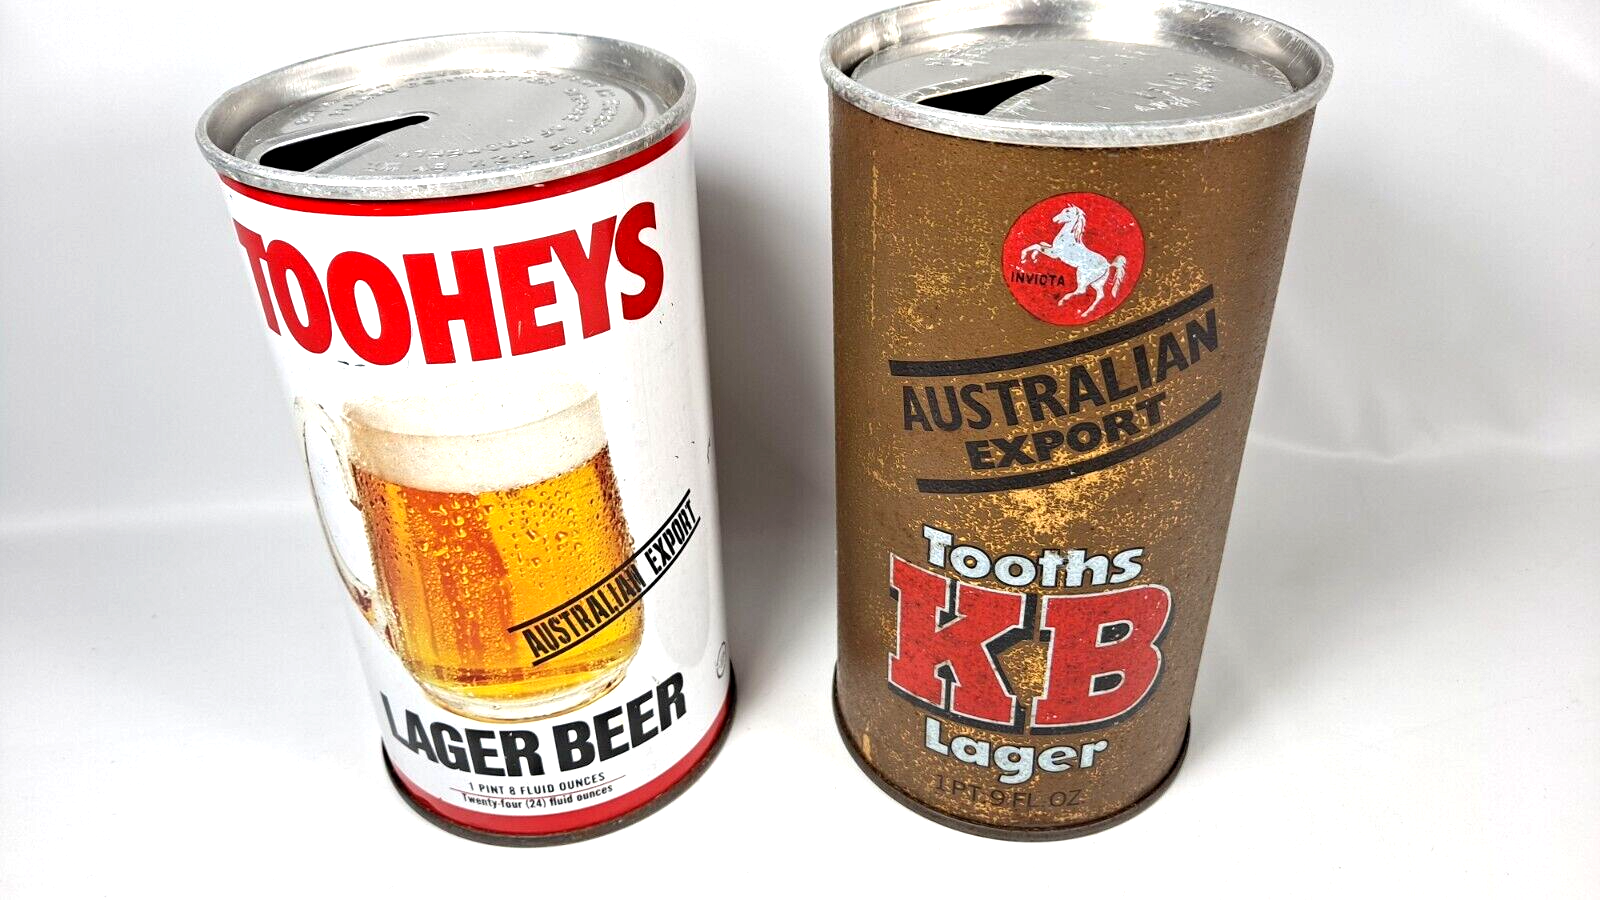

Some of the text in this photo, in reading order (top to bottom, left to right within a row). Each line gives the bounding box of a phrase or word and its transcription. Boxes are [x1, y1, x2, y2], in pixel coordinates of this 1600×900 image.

[232, 201, 664, 366] TOOHEYS
[1010, 270, 1066, 288] INVICTA
[903, 309, 1219, 432] AUSTRALIAN
[964, 392, 1167, 470] EXPORT
[522, 498, 698, 658] AUSTRALIAN EXPORT
[922, 525, 1144, 588] Tooths
[888, 551, 1175, 735] KB
[380, 672, 687, 777] LAGER BEER
[924, 716, 1110, 785] Lager
[462, 784, 614, 809] Twenty-four (24) fluid ounces
[469, 771, 606, 796] 1 PINT 8 FLUID OUNCES
[935, 774, 946, 792] 1
[990, 789, 1006, 807] 9
